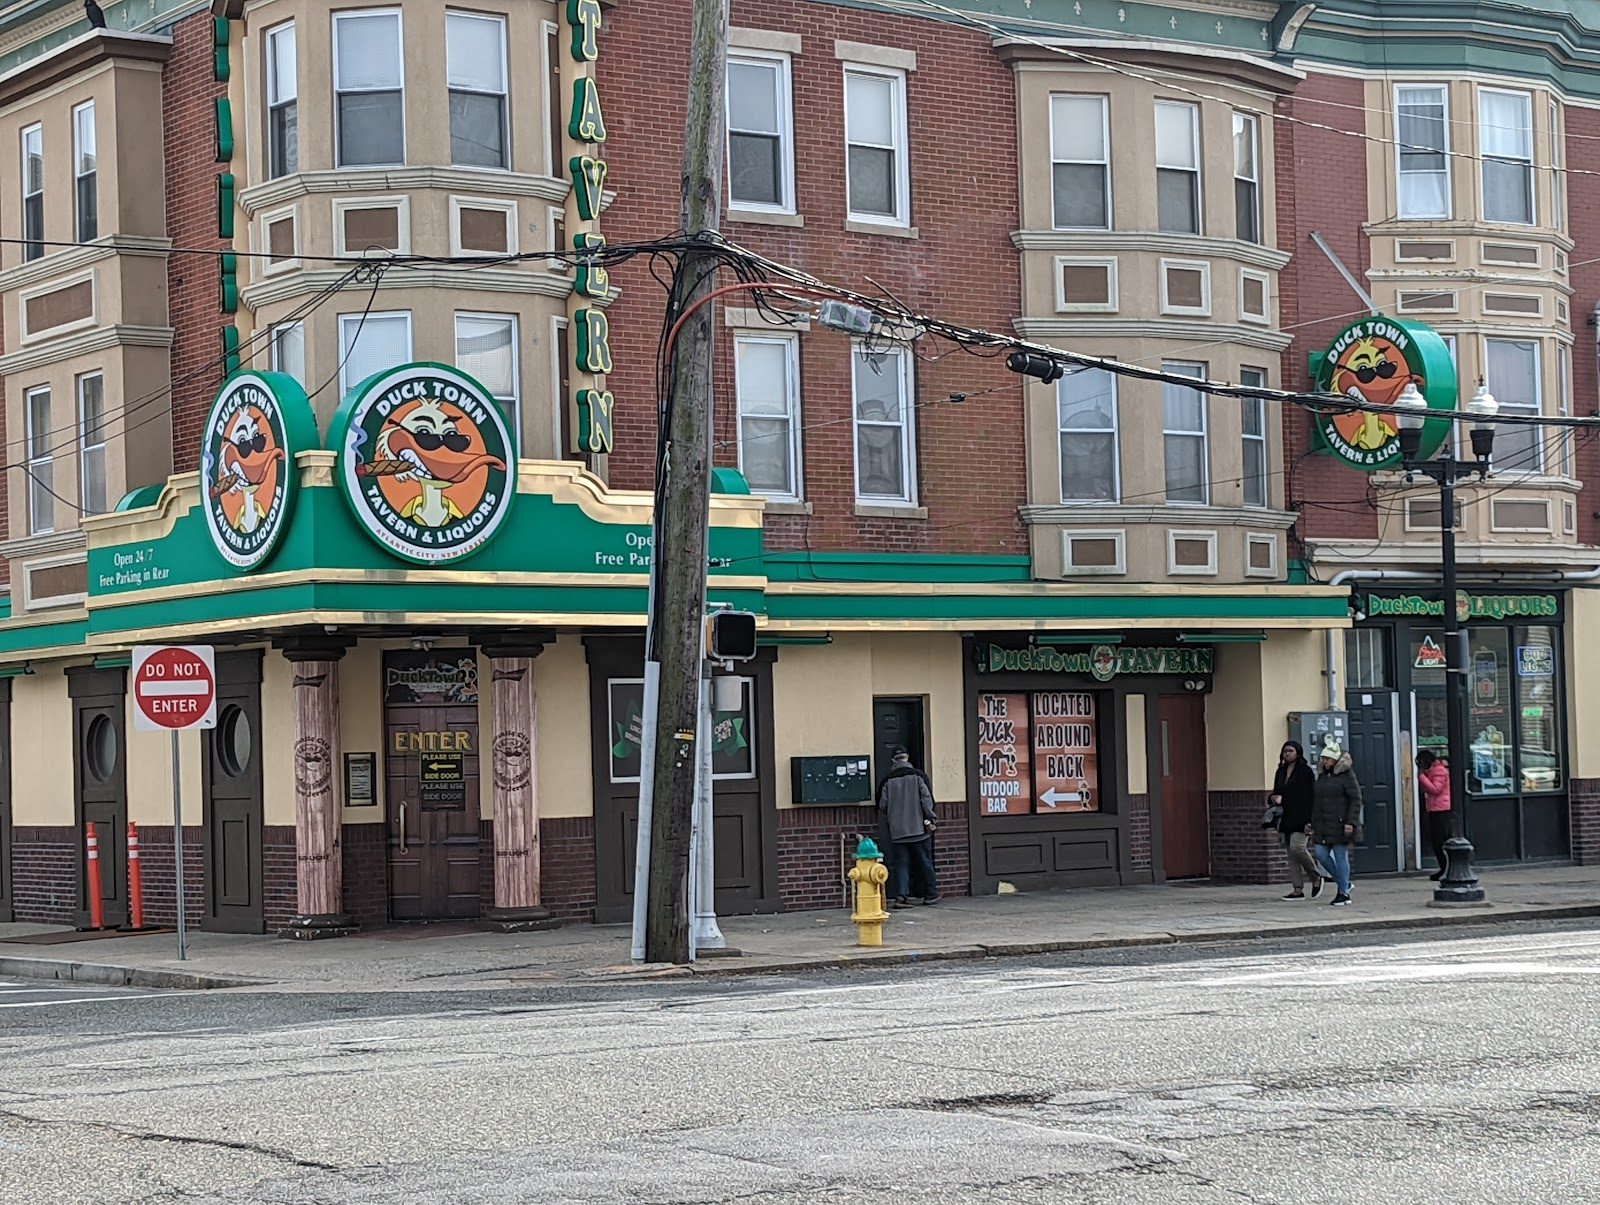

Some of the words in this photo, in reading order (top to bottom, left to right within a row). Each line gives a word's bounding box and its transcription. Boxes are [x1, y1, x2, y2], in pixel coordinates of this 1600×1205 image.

[577, 0, 614, 454] TAVERN
[1327, 323, 1364, 365] DUCK
[1366, 322, 1409, 350] TOWN
[216, 394, 242, 436] DUCK
[243, 388, 274, 420] TOWN
[376, 381, 427, 417] DUCK
[432, 381, 488, 426] TOWN
[1325, 423, 1363, 463] TAVERN
[1365, 453, 1374, 464] &
[215, 504, 242, 550] TAVERN
[244, 538, 251, 550] &
[252, 486, 282, 547] LIQUORS
[367, 485, 418, 540] TAVERN
[421, 530, 434, 544] &
[437, 491, 497, 544] LIQUORS
[376, 529, 414, 556] ATLANTIC
[442, 551, 458, 559] NEW
[625, 532, 652, 550] Ope
[114, 552, 133, 567] Open
[135, 548, 154, 563] 24/7
[595, 552, 624, 566] Free
[707, 556, 732, 568] ear
[99, 574, 114, 588] Free
[116, 571, 142, 585] Parking
[143, 569, 150, 581] in
[152, 568, 170, 580] Rear
[1470, 595, 1557, 619] LIQUORS
[145, 663, 165, 677] DO
[174, 663, 201, 676] NOT
[1119, 648, 1214, 674] TAVERN
[152, 699, 198, 713] ENTER
[1035, 693, 1092, 717] LOCATED
[395, 731, 472, 751] ENTER
[1037, 724, 1092, 748] AROUND
[1047, 755, 1085, 779] BACK
[980, 781, 1020, 797] UTDOOR
[987, 798, 1007, 813] BAR
